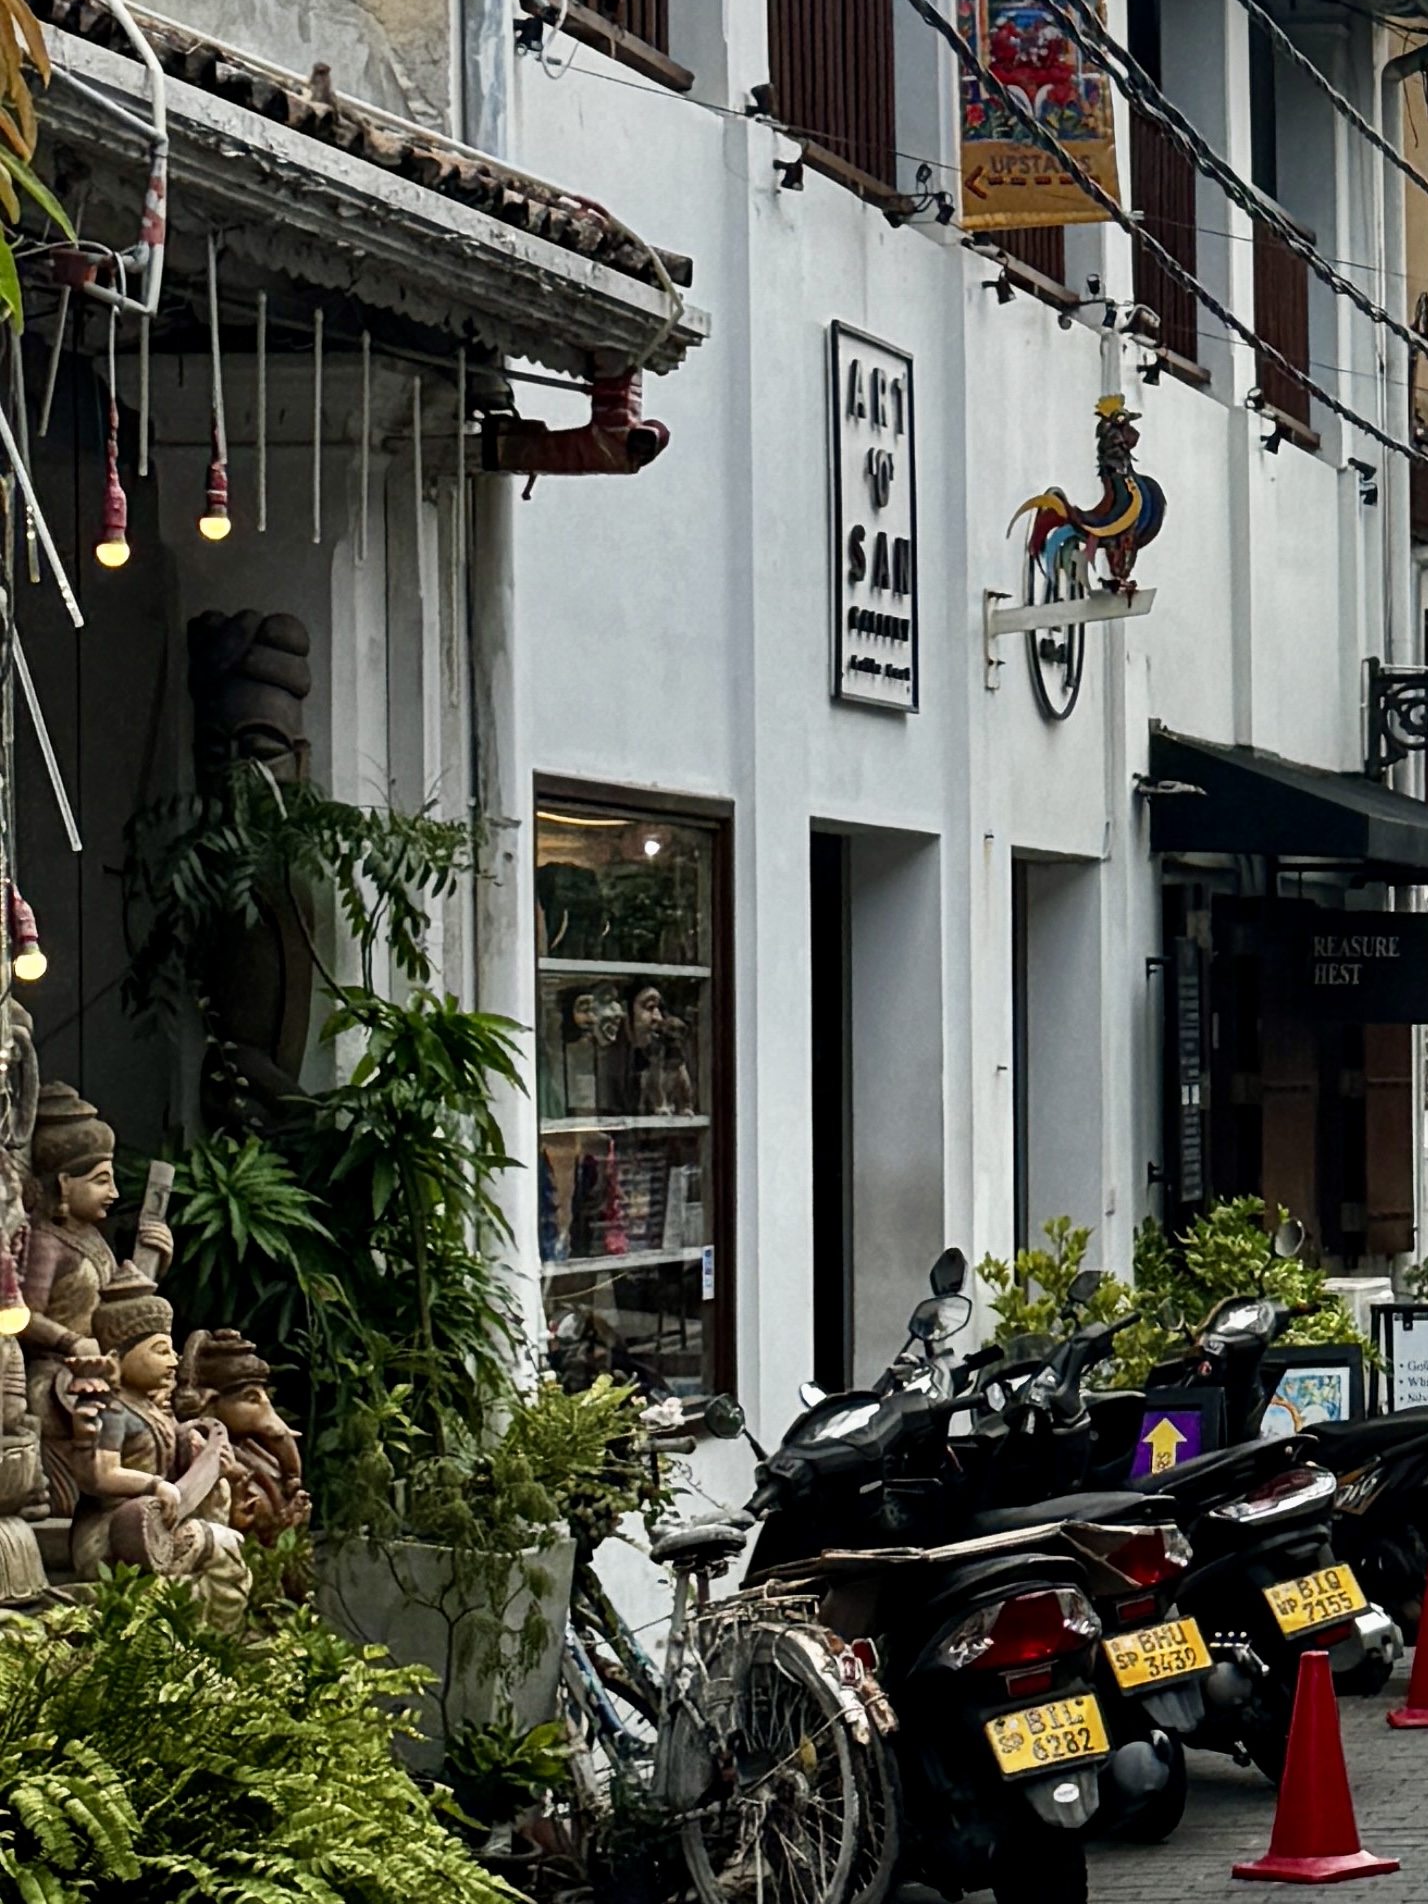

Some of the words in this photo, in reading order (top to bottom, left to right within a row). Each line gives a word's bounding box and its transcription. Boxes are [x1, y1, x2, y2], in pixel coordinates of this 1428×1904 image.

[990, 154, 1093, 175] UPSTAS
[847, 358, 906, 435] ART
[848, 524, 911, 595] SAN
[1302, 1590, 1354, 1622] 7155
[1115, 1651, 1139, 1670] SP
[998, 1731, 1025, 1754] SP
[1032, 1727, 1095, 1761] 6282
